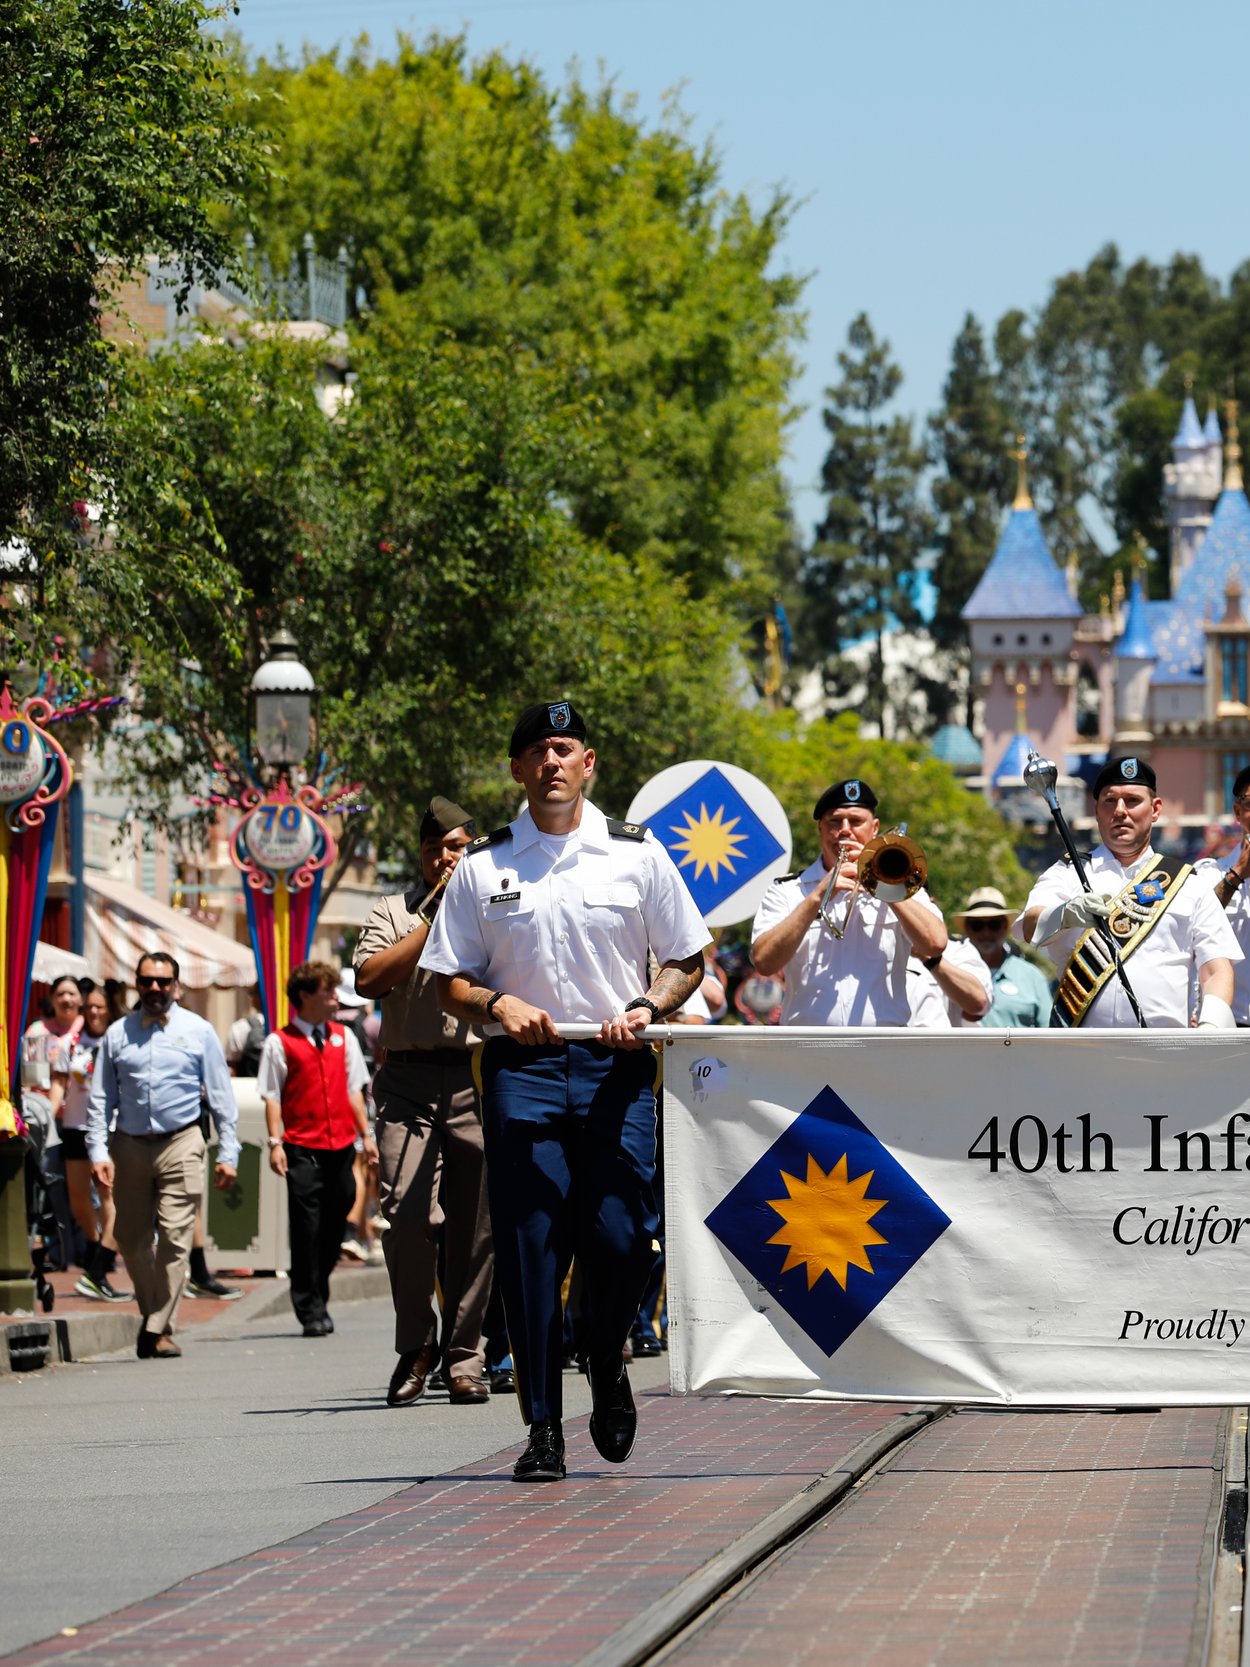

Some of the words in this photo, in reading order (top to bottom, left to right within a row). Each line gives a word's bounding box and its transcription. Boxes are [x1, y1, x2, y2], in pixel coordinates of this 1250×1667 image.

[2, 720, 31, 754] 0
[259, 805, 302, 831] 70
[697, 1065, 712, 1078] 10
[967, 1112, 1119, 1174] 40th
[1118, 1308, 1246, 1348] Proudly
